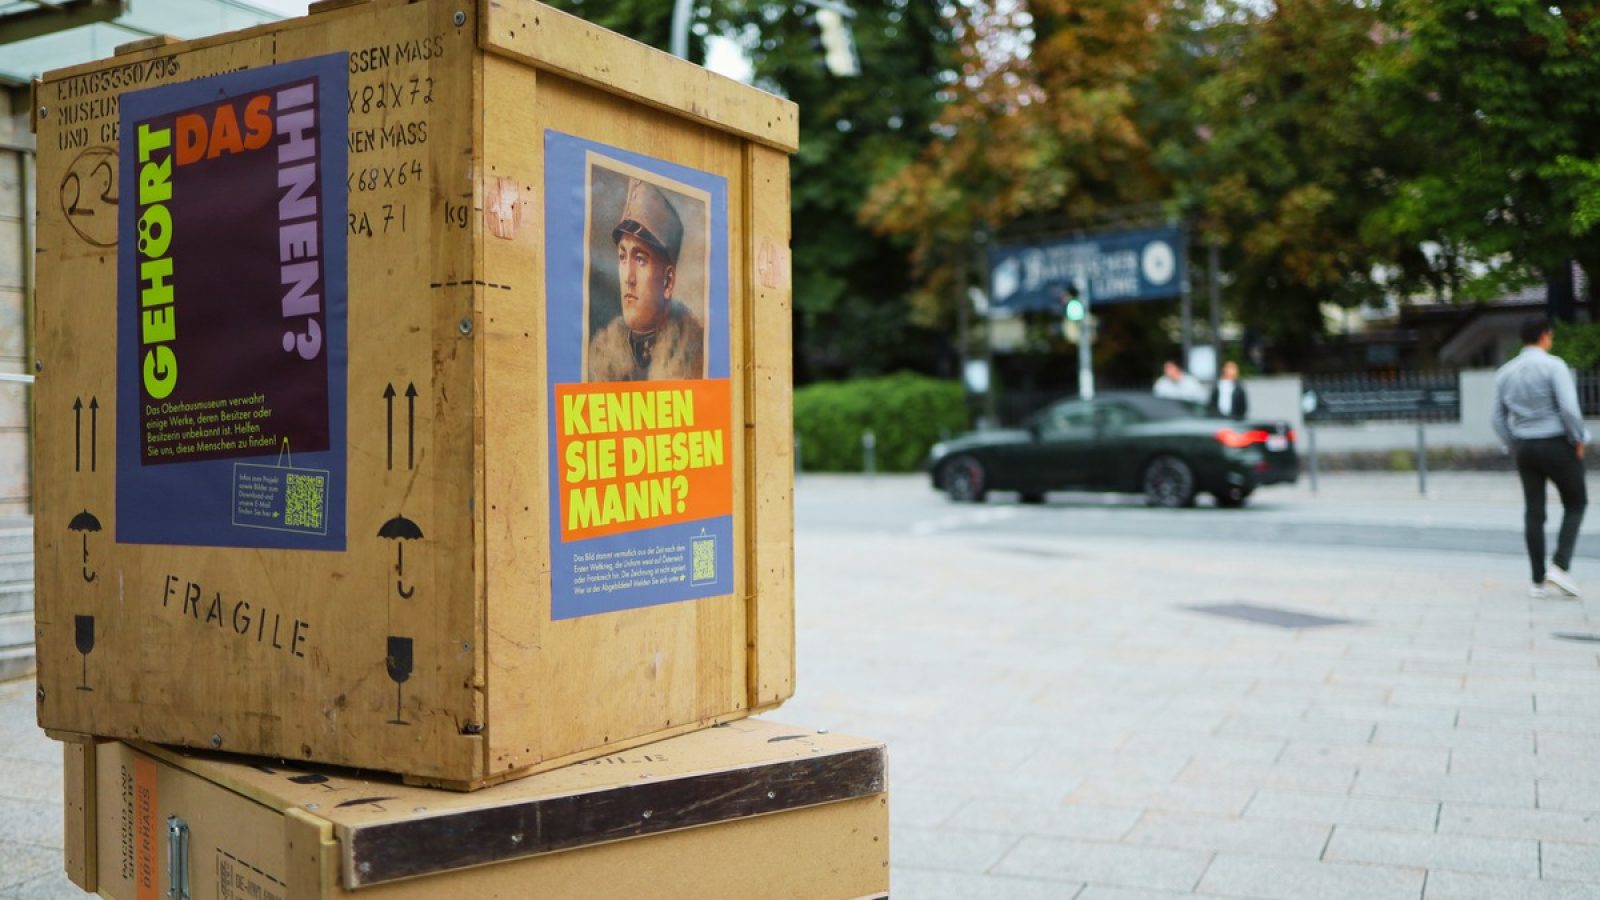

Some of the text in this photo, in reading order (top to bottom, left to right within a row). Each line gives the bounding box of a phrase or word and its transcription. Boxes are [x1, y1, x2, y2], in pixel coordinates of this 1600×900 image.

[395, 35, 443, 65] MASS
[58, 127, 89, 151] UND
[175, 95, 273, 167] DAS
[380, 121, 427, 149] MASS
[275, 83, 322, 360] IHNEN?
[445, 201, 468, 229] kg
[137, 123, 178, 400] GEHÖRT
[146, 392, 265, 416] Das Oberhausmuseum verwahrt
[146, 406, 272, 431] einige Werke, deren Besitzer oder
[563, 389, 694, 436] KENNEN
[147, 431, 180, 443] Besitzerin
[181, 426, 220, 440] unbekannt
[234, 421, 260, 434] Helfen
[147, 446, 159, 457] Sie
[176, 442, 196, 455] diese
[196, 438, 237, 452] Menschen
[238, 440, 247, 449] zu
[248, 434, 277, 447] finden!
[565, 429, 724, 484] SIE DIESEN
[568, 475, 689, 531] MANN?
[163, 574, 309, 658] FRAGILE
[142, 787, 152, 889] OBERHAUS
